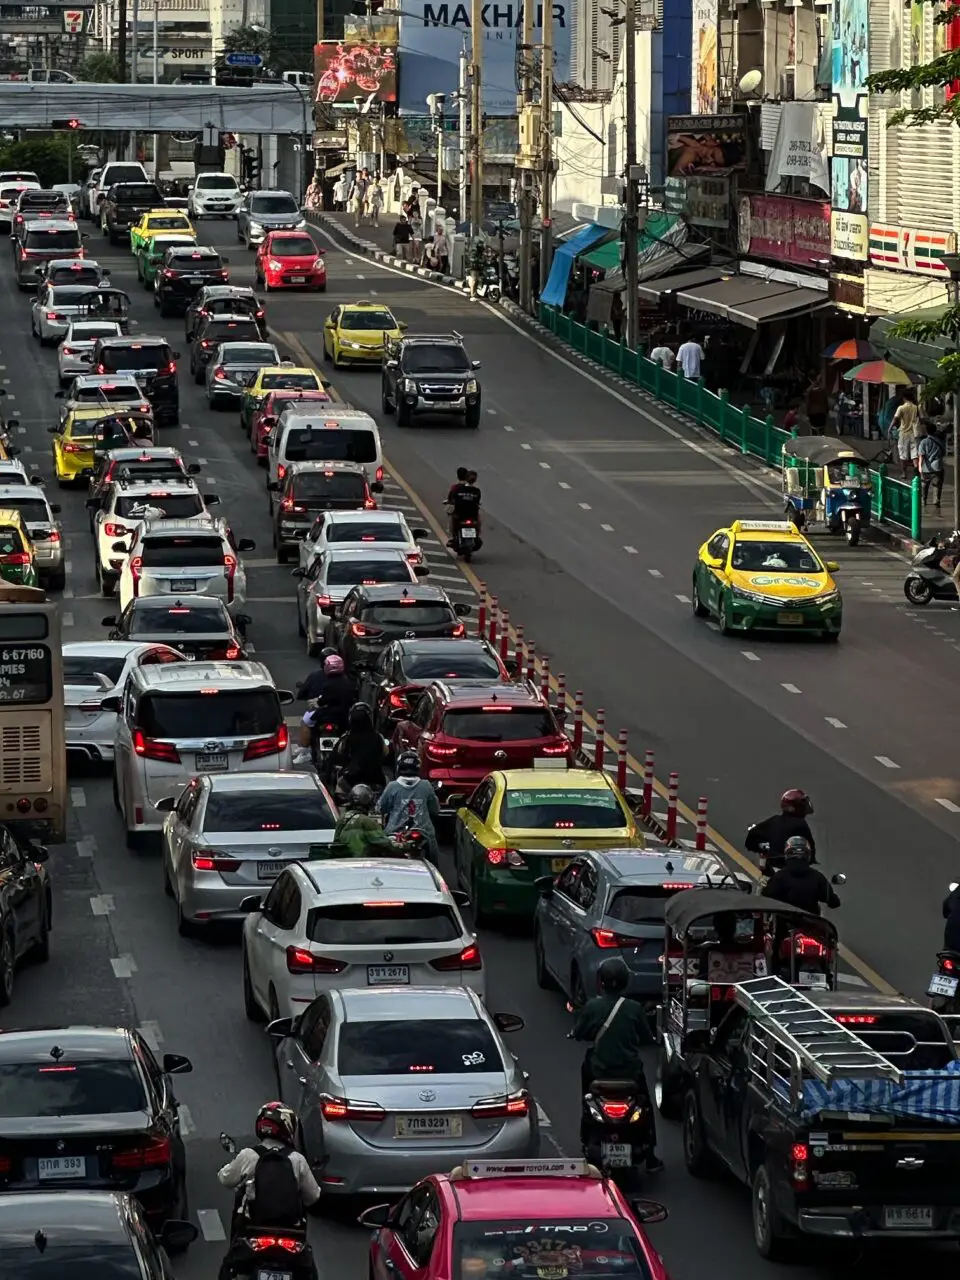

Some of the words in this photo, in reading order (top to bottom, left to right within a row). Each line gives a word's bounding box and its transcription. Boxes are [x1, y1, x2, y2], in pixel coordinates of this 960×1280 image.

[171, 49, 205, 59] SPORT
[751, 576, 821, 588] Grab
[13, 690, 25, 699] 67
[64, 1159, 81, 1168] 393
